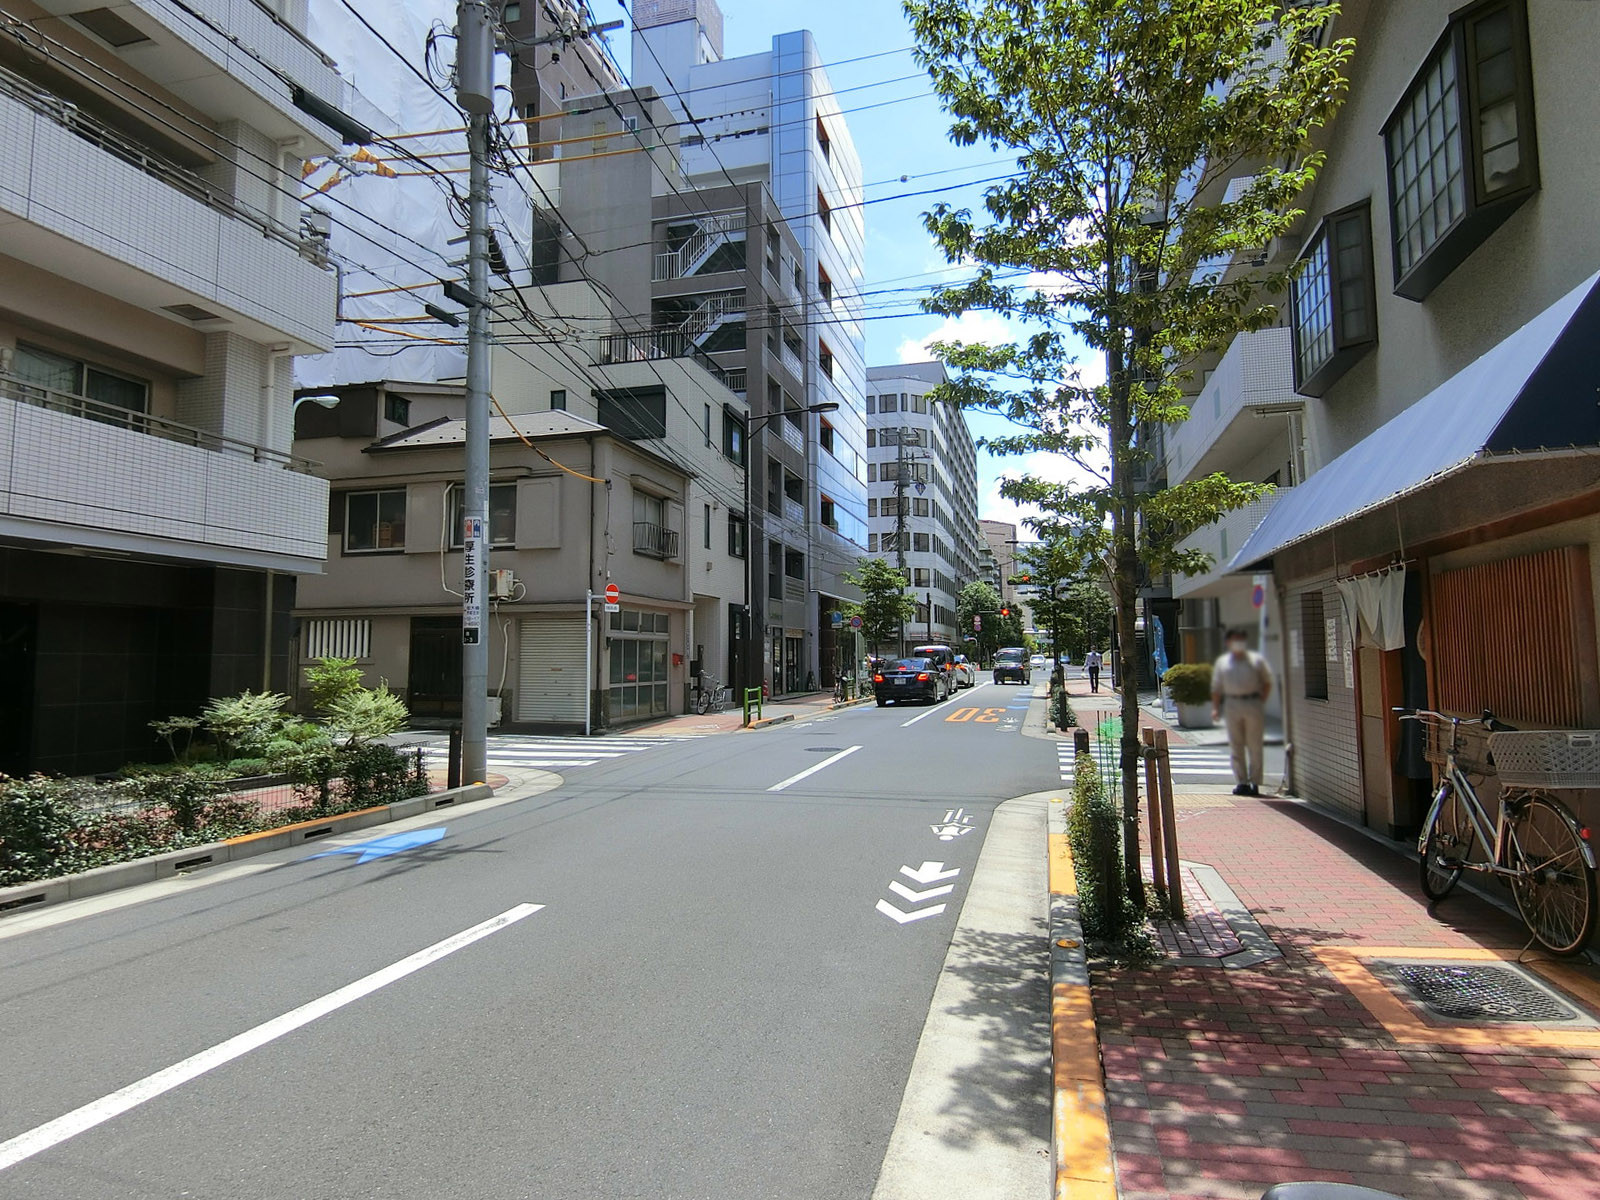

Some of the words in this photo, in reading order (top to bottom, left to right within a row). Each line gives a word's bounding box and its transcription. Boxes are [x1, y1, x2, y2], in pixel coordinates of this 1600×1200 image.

[465, 541, 475, 604] 厚生診療所
